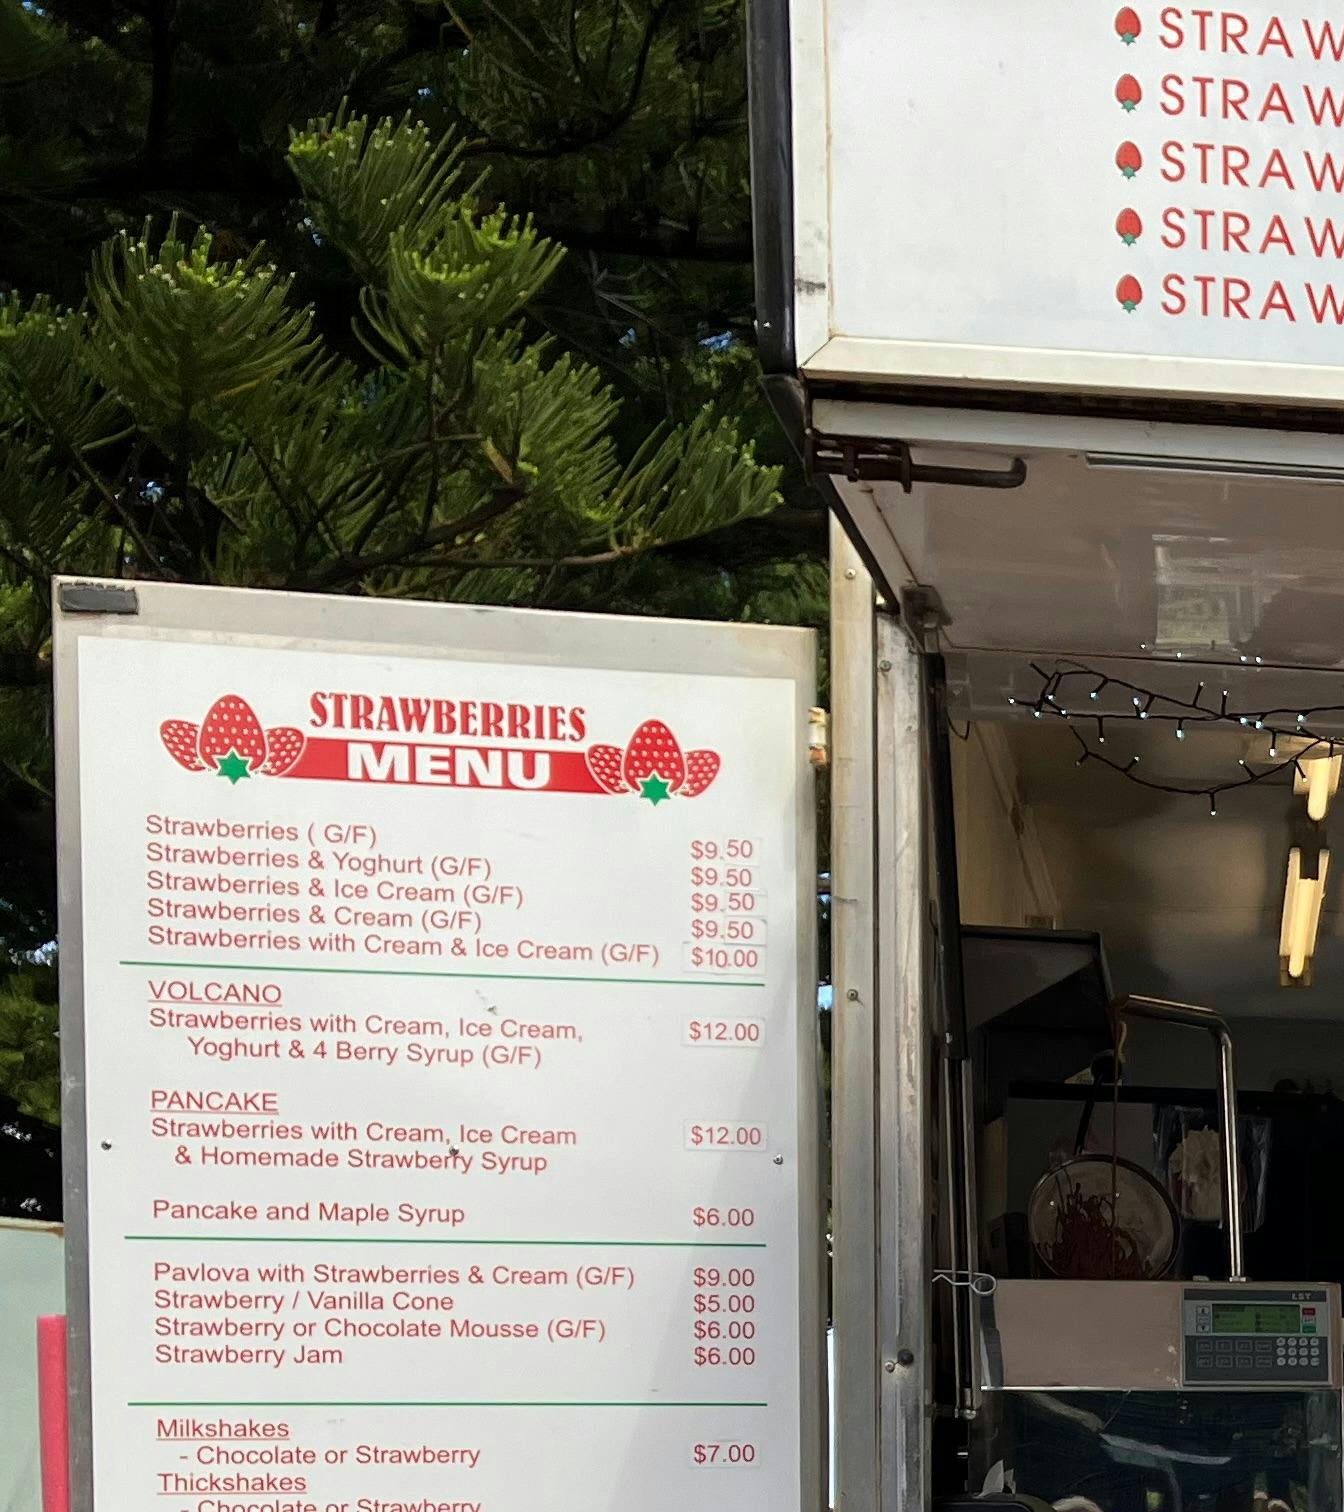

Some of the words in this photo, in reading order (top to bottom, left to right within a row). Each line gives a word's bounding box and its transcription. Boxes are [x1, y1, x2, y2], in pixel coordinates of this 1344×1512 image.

[310, 692, 586, 741] STRAWBERRIES
[346, 742, 551, 791] MENU
[150, 1090, 279, 1114] PANCAKE
[151, 1115, 305, 1142] Strawberries
[311, 1120, 360, 1142] with
[365, 1120, 451, 1146] Cream,
[458, 1125, 495, 1144] Ice
[500, 1123, 577, 1146] Cream
[690, 1124, 762, 1147] $12.00
[175, 1144, 193, 1167] &
[200, 1146, 342, 1169] Homemade
[347, 1146, 474, 1176] Strawberry
[482, 1150, 550, 1176] Syrup
